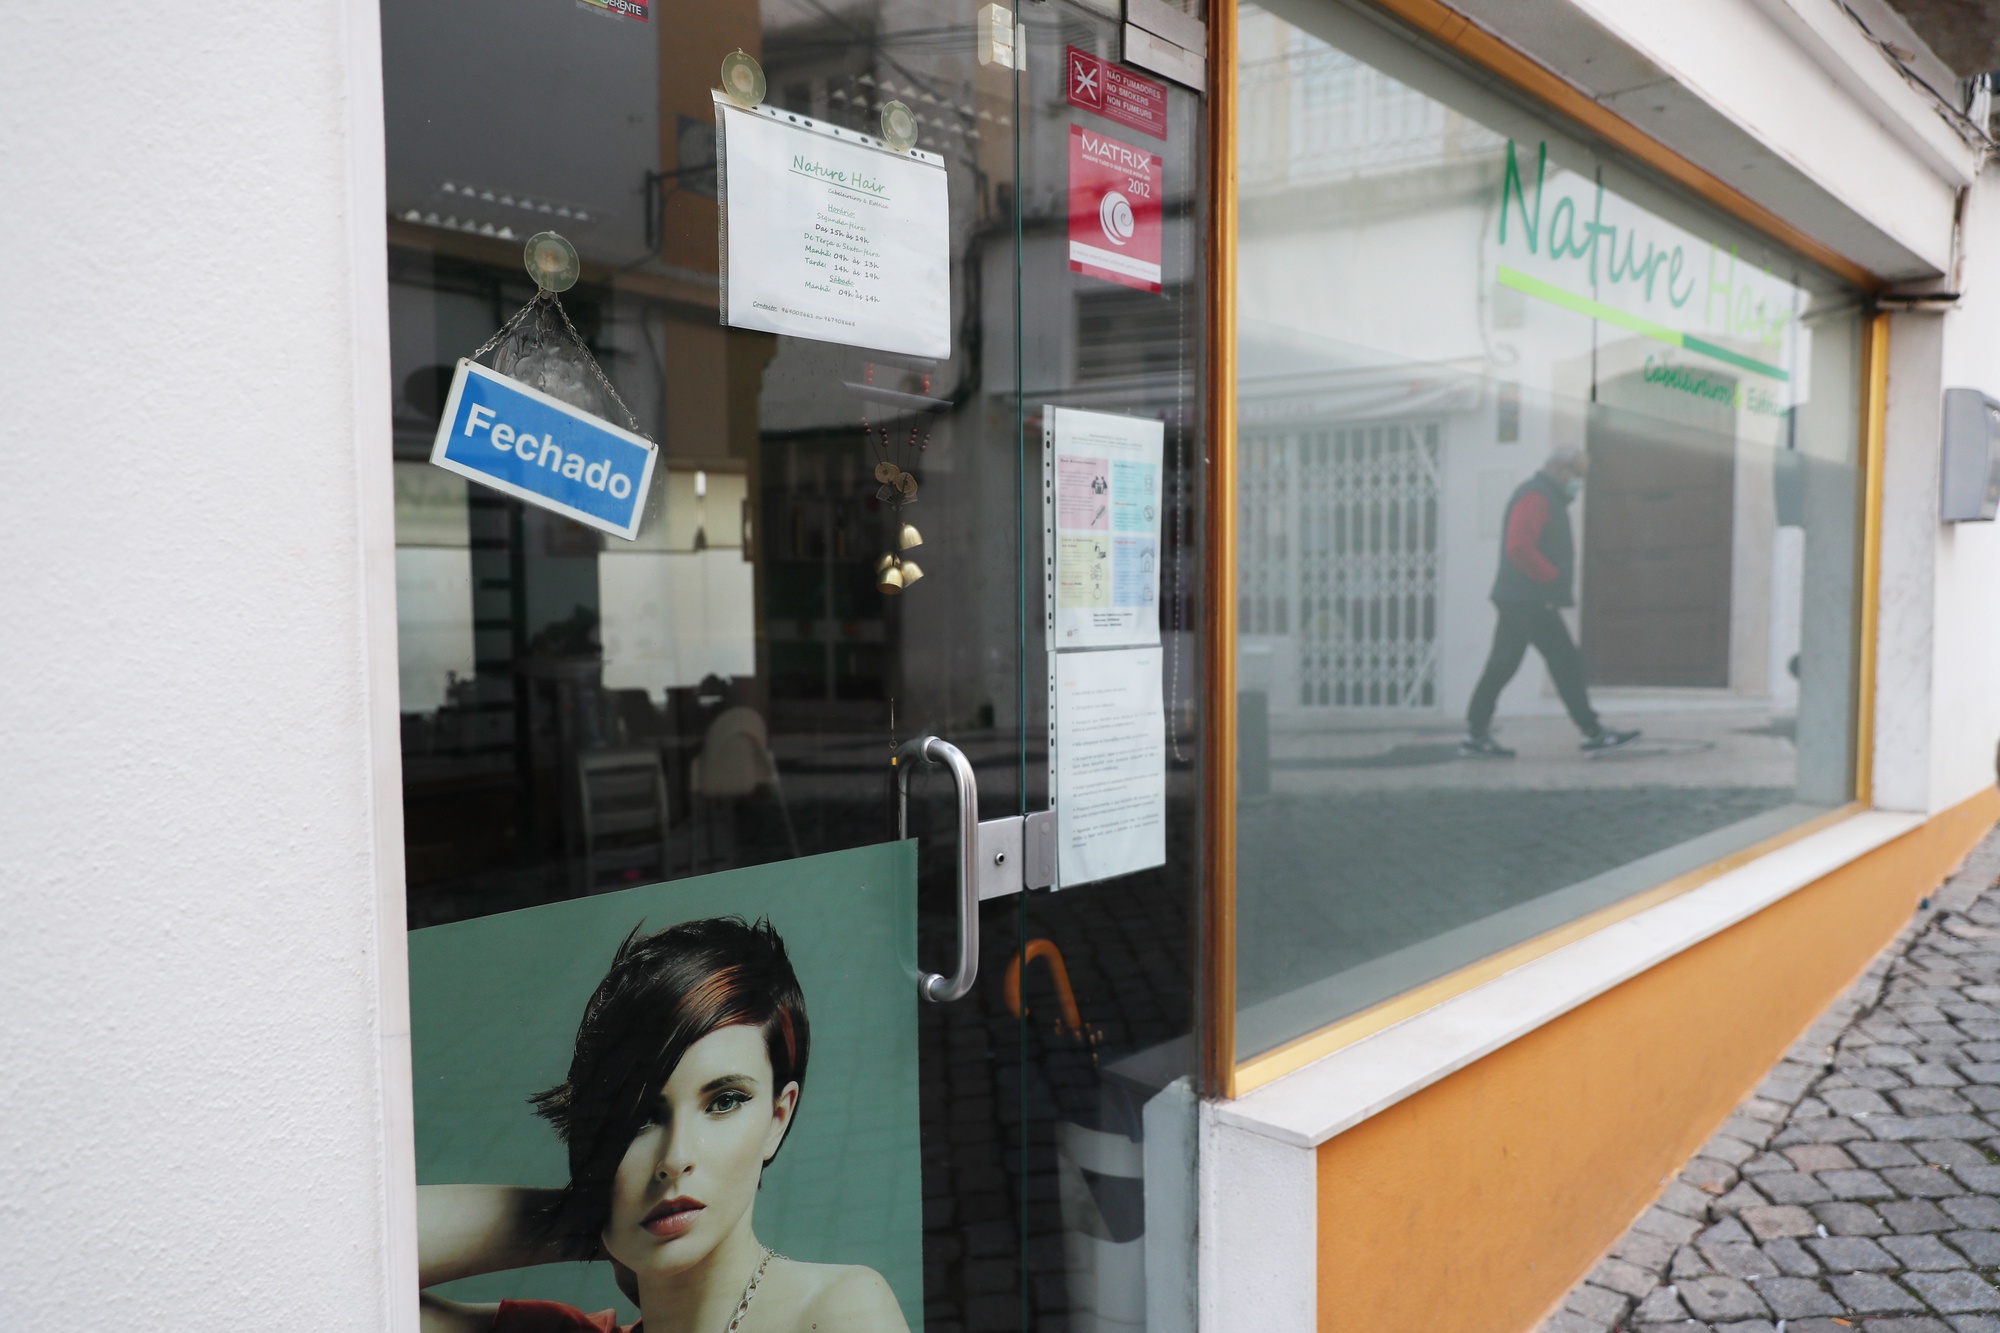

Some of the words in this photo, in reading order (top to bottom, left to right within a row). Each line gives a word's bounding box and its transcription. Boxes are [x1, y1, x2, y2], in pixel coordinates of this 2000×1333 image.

[600, 0, 642, 16] ERENTE
[1106, 83, 1117, 93] NO
[1119, 88, 1149, 107] SMOKERS
[1123, 77, 1161, 99] FUMADORES
[1106, 95, 1121, 107] NON
[1123, 102, 1153, 120] FUMEURS
[1082, 133, 1150, 174] MATRIX
[793, 154, 848, 182] Nature
[851, 172, 885, 194] Hair
[1128, 178, 1150, 198] 2012
[804, 232, 814, 241] De
[815, 235, 835, 247] Terça
[815, 223, 829, 233] Das
[830, 228, 845, 237] 15h
[855, 235, 870, 244] 19h
[1499, 138, 1696, 309] Nature
[1705, 240, 1793, 352] Hair
[804, 245, 832, 258] Manhã:
[833, 252, 849, 262] 09h
[852, 257, 860, 265] às
[864, 260, 880, 269] 13h
[804, 257, 827, 268] Tarde:
[834, 264, 849, 273] 14h
[852, 268, 861, 277] às
[865, 271, 880, 280] 19h
[838, 289, 854, 298] 09h
[865, 294, 880, 303] 14h
[463, 402, 632, 500] Fechado
